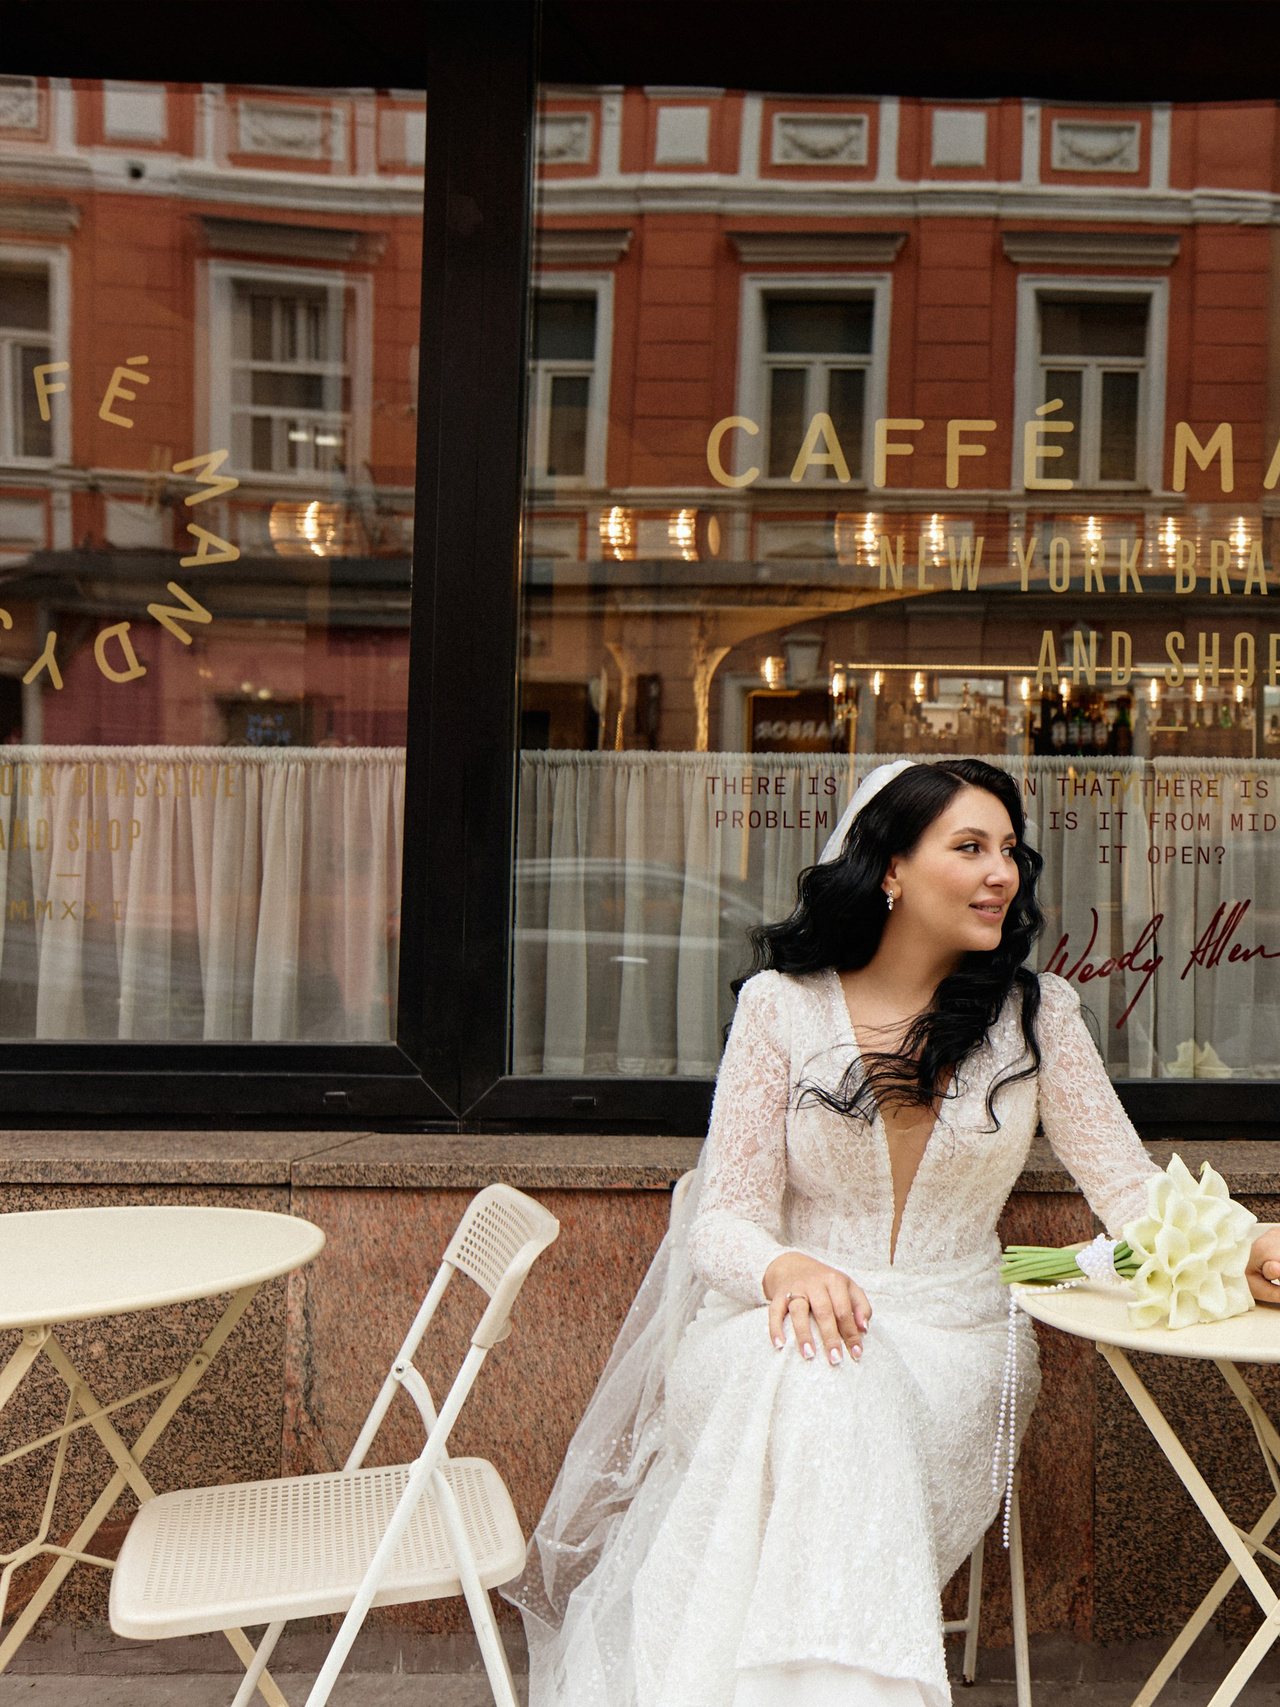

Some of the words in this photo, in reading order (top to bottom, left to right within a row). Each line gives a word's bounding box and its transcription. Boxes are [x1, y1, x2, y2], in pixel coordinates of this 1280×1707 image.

[706, 398, 1075, 490] CAFFÉ
[879, 535, 985, 592] NEW
[1016, 536, 1144, 594] YORK
[1035, 630, 1133, 686] AND
[74, 764, 236, 798] BRASSERIE
[706, 777, 787, 796] THERE
[808, 777, 837, 796] IS
[1057, 778, 1121, 797] THAT
[1140, 779, 1219, 798] THERE
[1240, 780, 1269, 799] IS
[1066, 770, 1259, 807] MMXXI
[67, 818, 142, 852] SHOP
[715, 810, 828, 829] PROBLEM
[1049, 812, 1078, 830] IS
[1099, 812, 1128, 831] IT
[1149, 813, 1211, 832] FROM
[1099, 845, 1128, 863] IT
[1147, 846, 1226, 865] OPEN?
[9, 900, 123, 921] MMXXI
